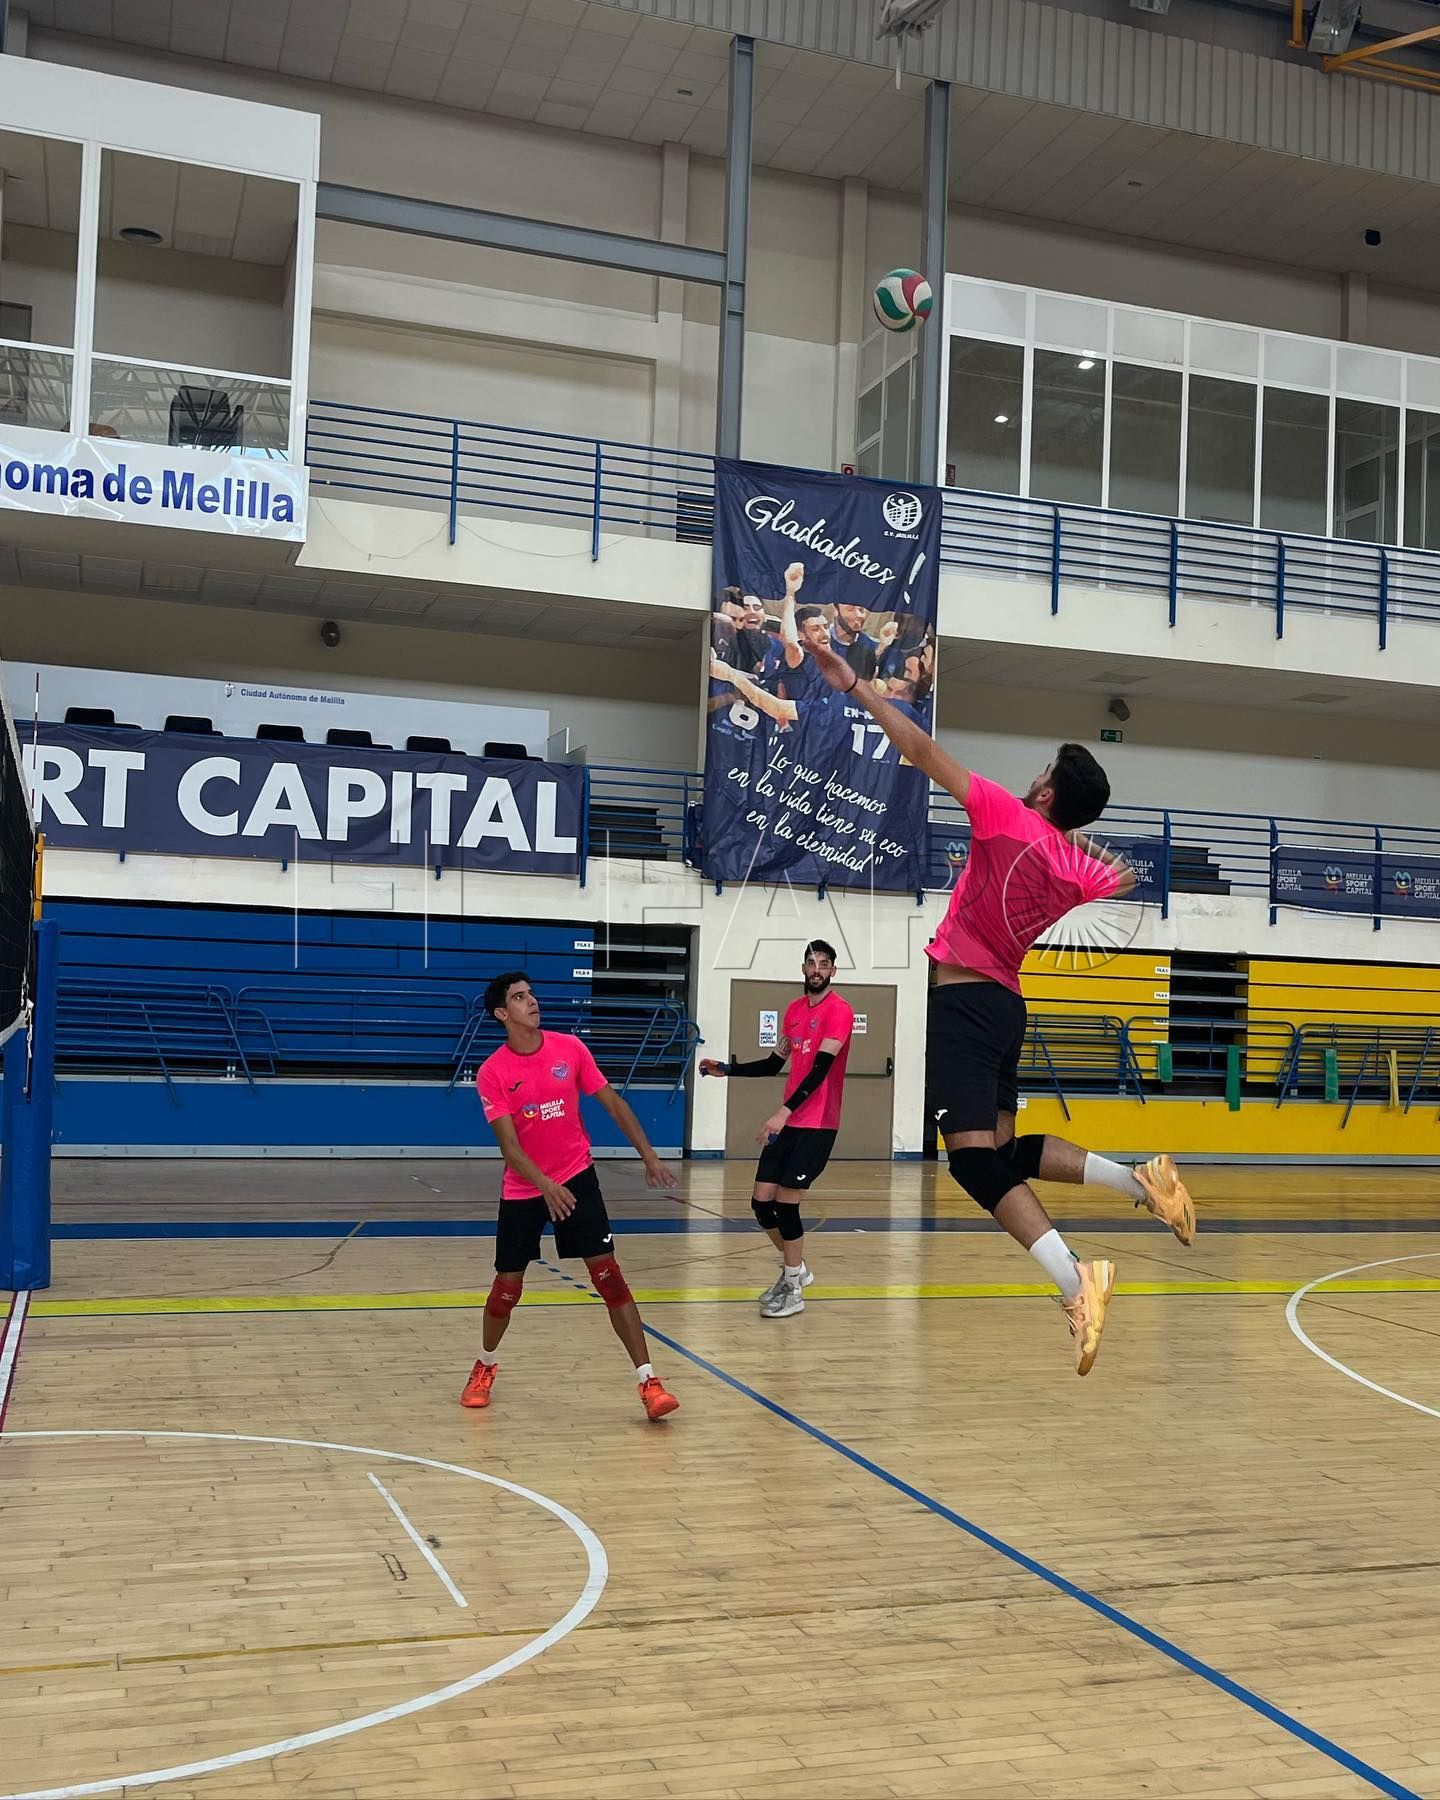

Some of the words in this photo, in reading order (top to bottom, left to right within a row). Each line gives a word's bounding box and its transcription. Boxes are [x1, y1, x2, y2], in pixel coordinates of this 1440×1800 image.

[0, 461, 94, 499] oma
[102, 464, 153, 504] de
[161, 470, 294, 522] Melilla
[744, 495, 896, 585] Gladiadores
[240, 688, 267, 698] Ciudad
[268, 690, 307, 702] Autónoma
[308, 695, 318, 703] de
[320, 695, 345, 705] Melilla
[851, 723, 891, 760] 17
[789, 764, 822, 790] que
[824, 769, 888, 816] hacemos
[177, 756, 578, 854] CAPITAL
[728, 767, 751, 788] en
[755, 769, 775, 797] la
[779, 790, 812, 815] vida
[815, 802, 856, 834] tiene
[859, 828, 877, 845] su
[879, 838, 908, 858] eco
[746, 810, 770, 831] en
[774, 812, 794, 840] la
[1277, 868, 1302, 877] MELILLA
[1346, 872, 1373, 881] MELILLA
[1276, 883, 1303, 891] CAPITAL
[1414, 877, 1440, 885] MELILLA
[1346, 887, 1373, 895] CAPITAL
[540, 1098, 565, 1109] MELILLA
[541, 1105, 560, 1115] SPORT
[541, 1110, 565, 1121] CAPITAL
